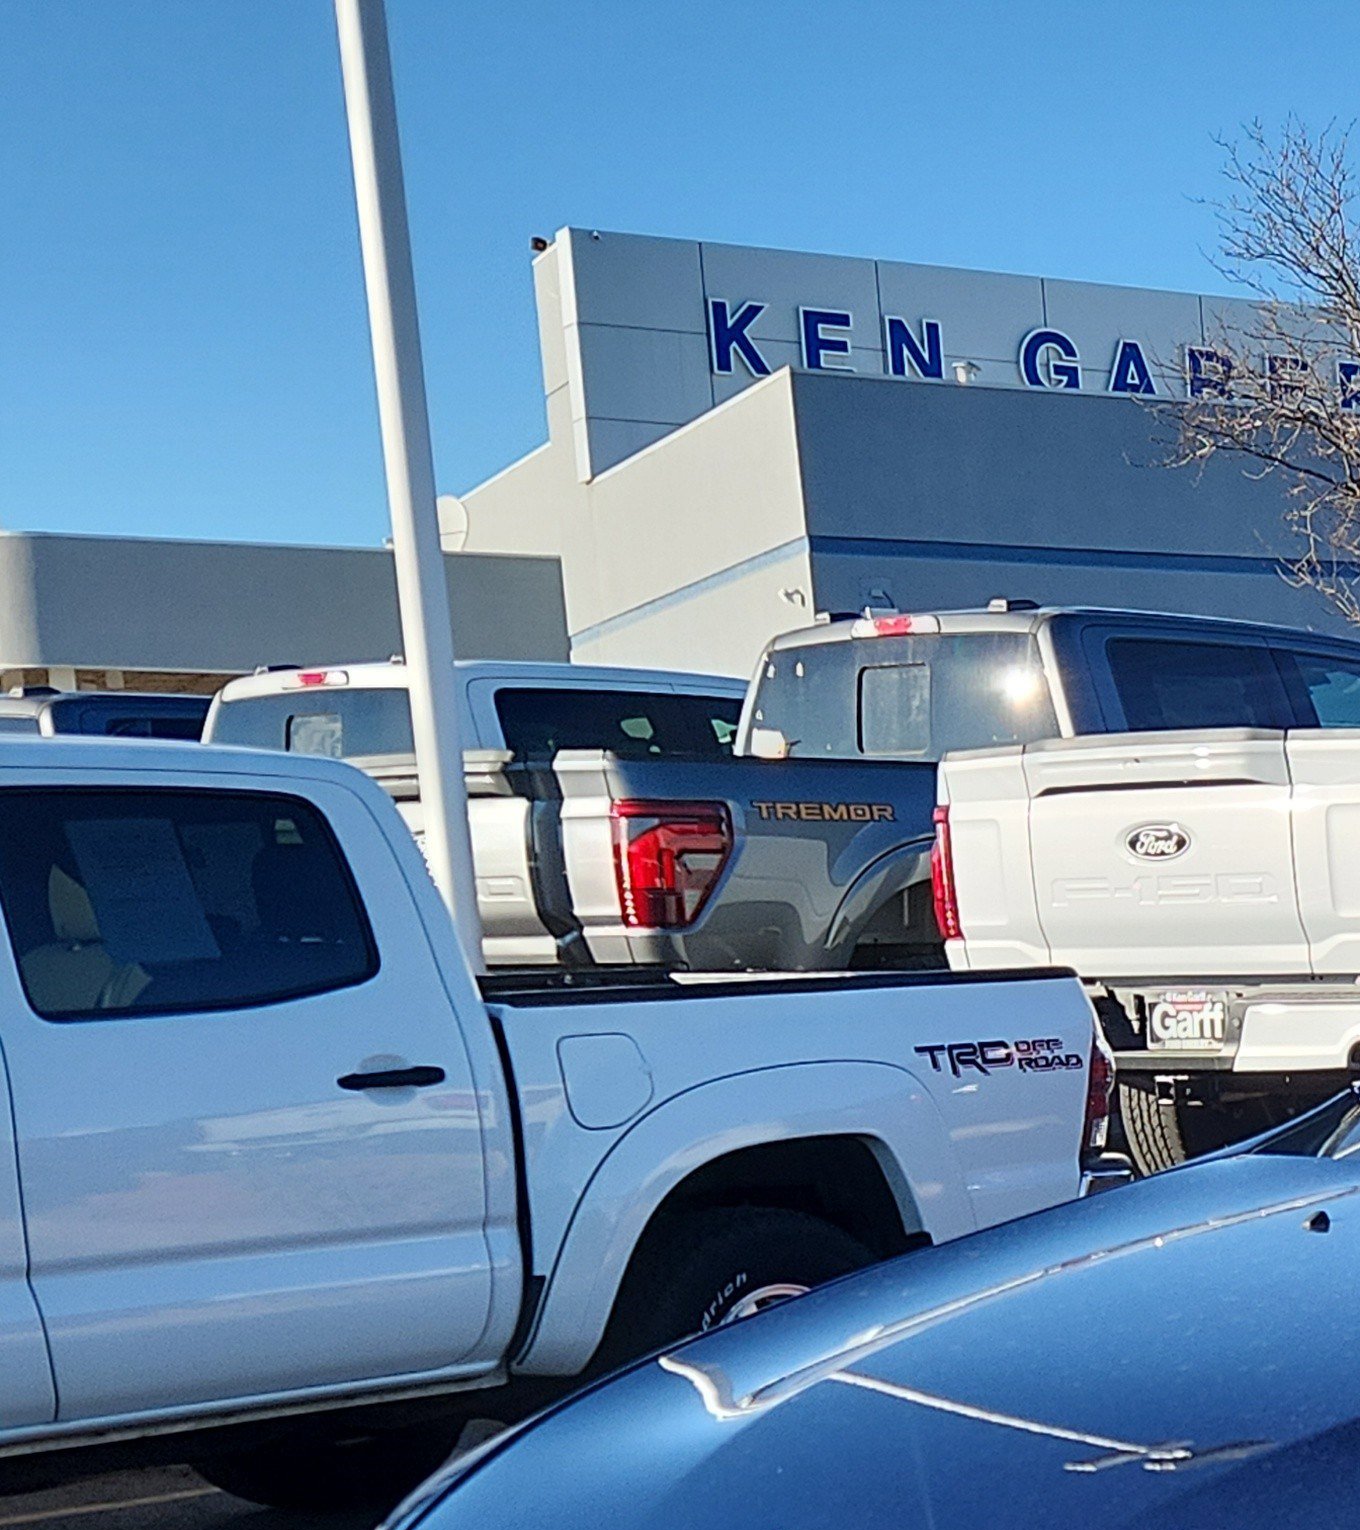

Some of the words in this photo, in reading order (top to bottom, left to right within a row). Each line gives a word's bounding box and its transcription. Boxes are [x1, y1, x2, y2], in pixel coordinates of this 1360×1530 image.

[707, 297, 946, 379] KEN
[751, 801, 895, 822] TREMOR
[1135, 828, 1180, 855] Ford
[1152, 1002, 1224, 1040] Garff
[914, 1040, 1014, 1078] TRD
[1017, 1054, 1083, 1073] ROAD
